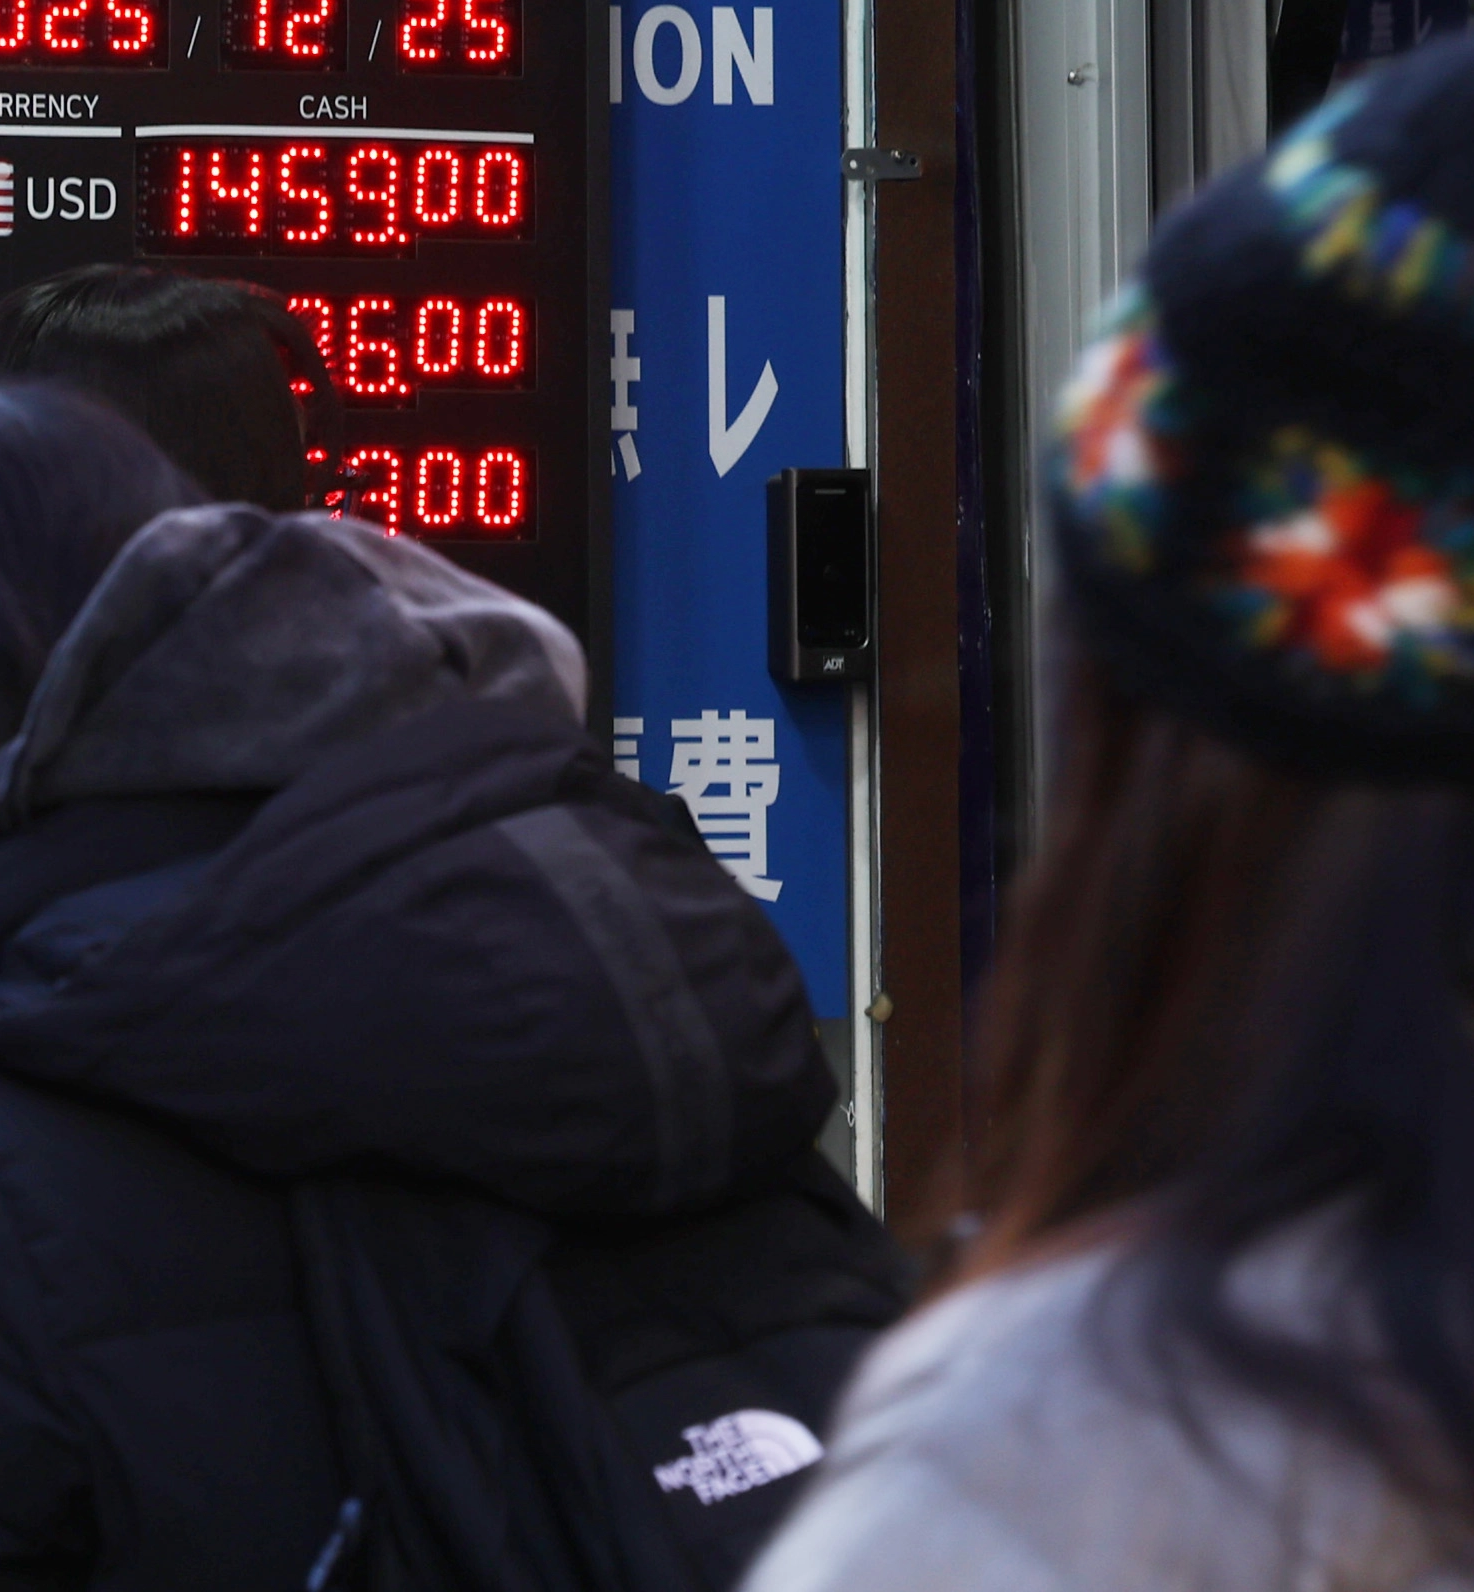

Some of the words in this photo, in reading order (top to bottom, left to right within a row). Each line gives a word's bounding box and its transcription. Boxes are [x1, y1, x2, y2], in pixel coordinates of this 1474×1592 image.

[299, 95, 367, 120] CASH
[27, 177, 117, 220] USD
[176, 143, 525, 245] 1459.00
[823, 657, 844, 670] ADT
